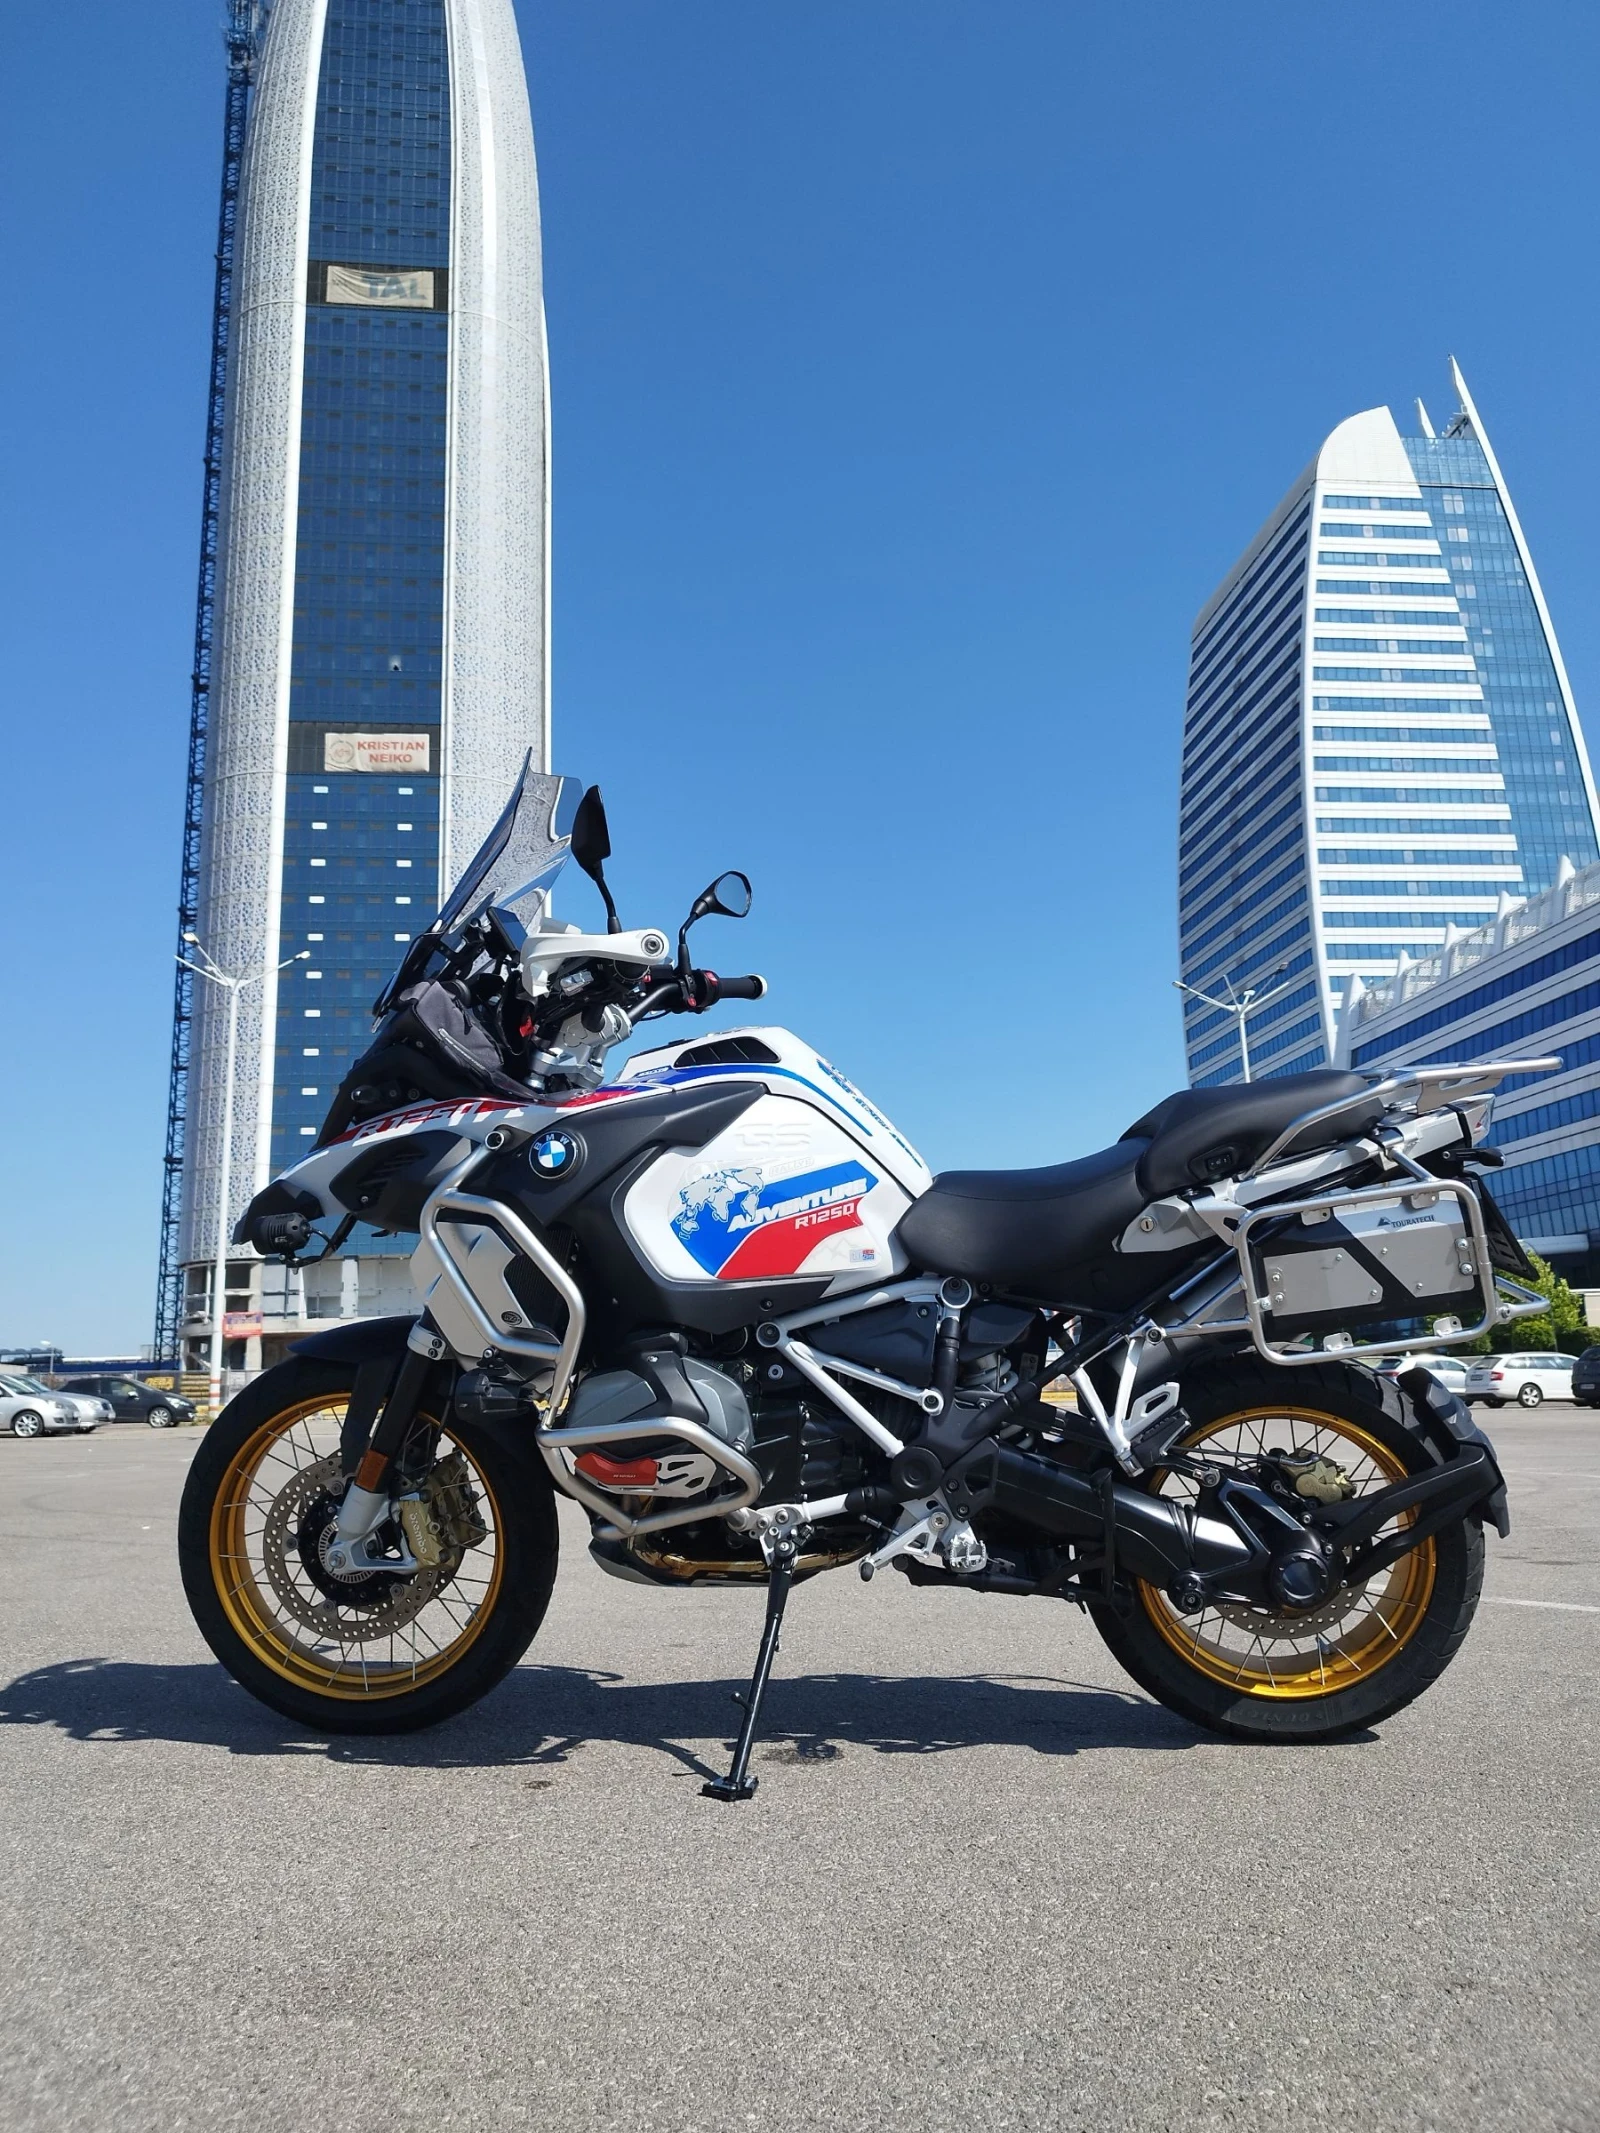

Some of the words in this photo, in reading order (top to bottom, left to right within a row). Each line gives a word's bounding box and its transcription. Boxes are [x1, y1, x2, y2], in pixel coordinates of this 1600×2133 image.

[357, 741, 425, 751] KRISTIAN
[369, 754, 412, 763] NEIKO
[534, 1133, 570, 1151] BMW
[795, 1202, 855, 1230] R1250
[1391, 1214, 1435, 1228] TOURATECH
[410, 1512, 427, 1554] brembo
